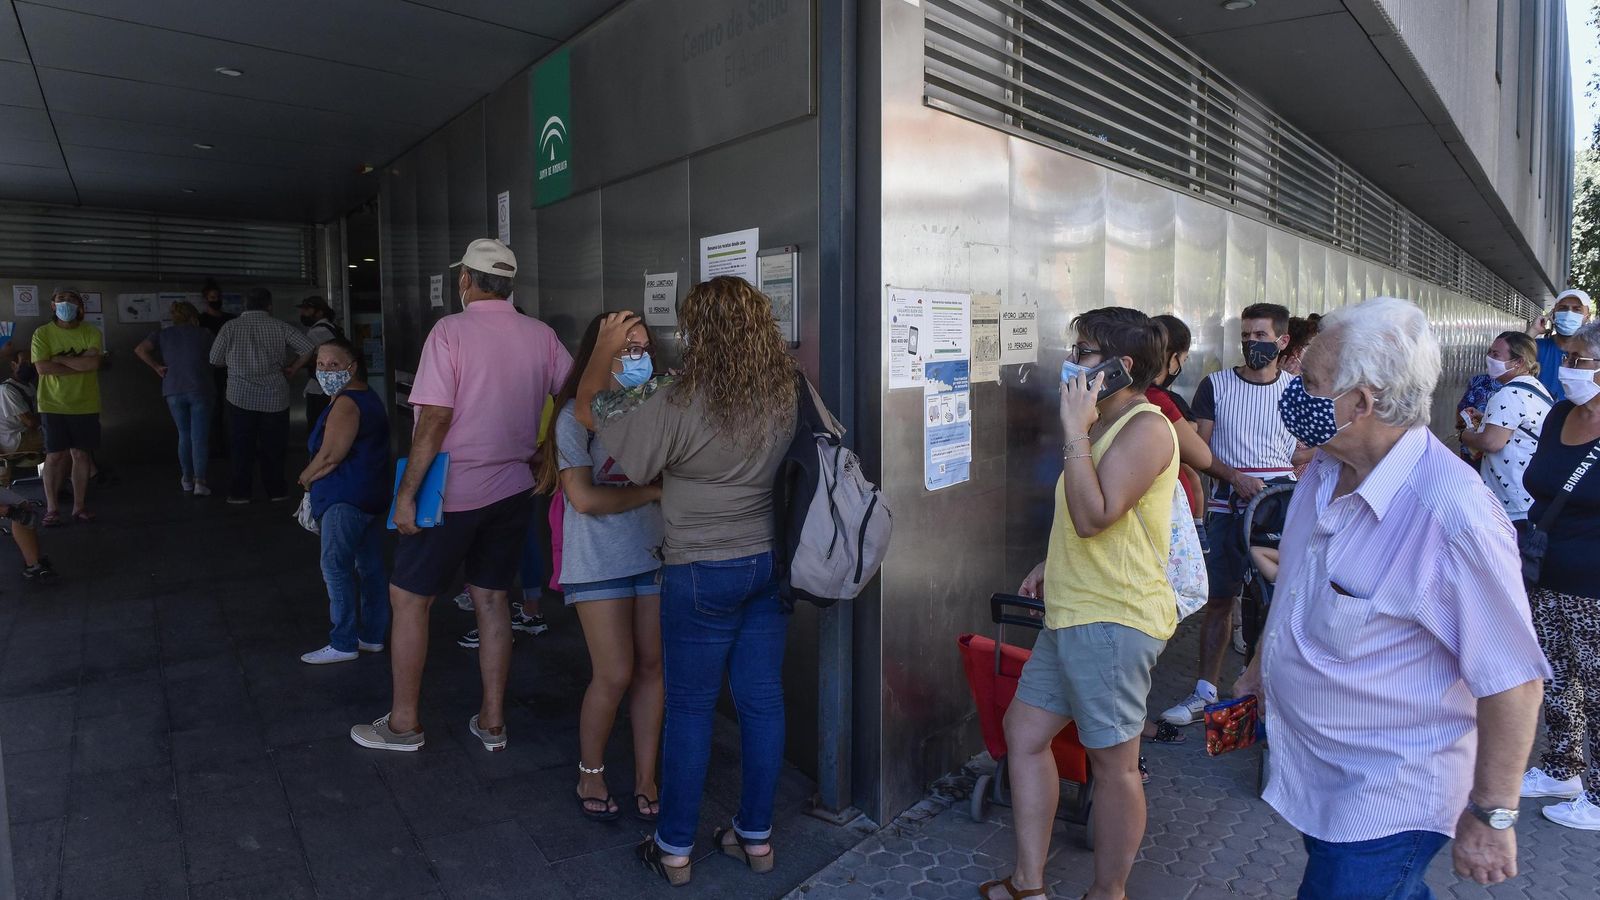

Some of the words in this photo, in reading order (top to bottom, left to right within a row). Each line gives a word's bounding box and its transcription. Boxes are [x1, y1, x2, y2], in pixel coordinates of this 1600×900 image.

[683, 24, 722, 62] Centro
[728, 9, 743, 40] de
[1014, 341, 1033, 349] PERSONAS
[1563, 461, 1592, 492] BIMBA
[1586, 451, 1598, 460] Y
